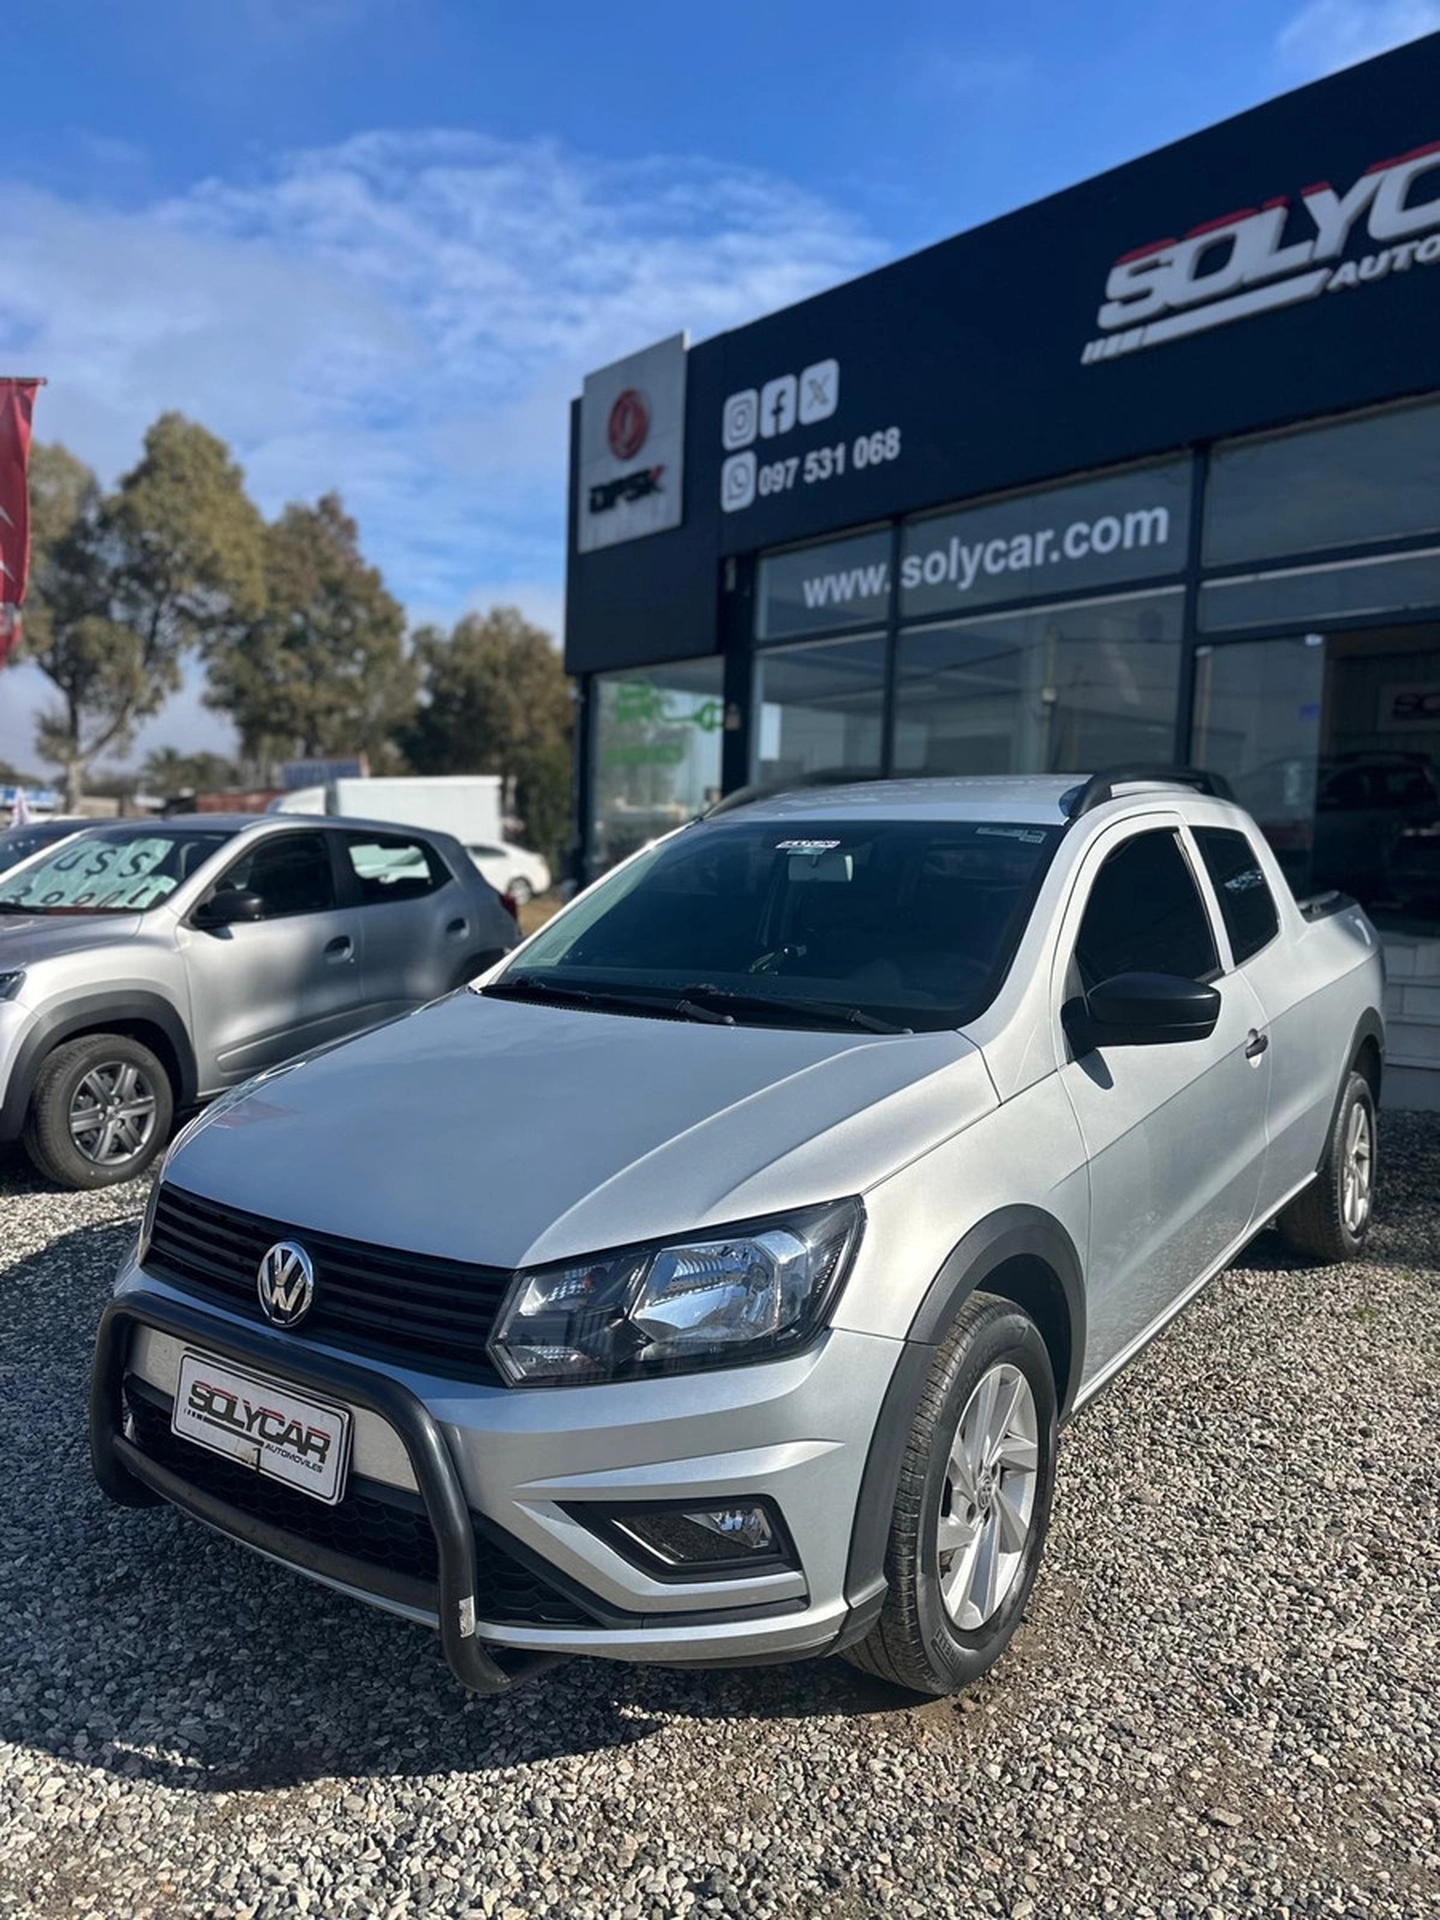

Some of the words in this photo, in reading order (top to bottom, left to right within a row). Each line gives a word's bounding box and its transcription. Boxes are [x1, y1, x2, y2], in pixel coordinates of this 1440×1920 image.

[758, 456, 800, 496] 097
[803, 442, 846, 484] 531
[852, 426, 901, 469] 068
[188, 1380, 331, 1464] SOLYCAR
[264, 1443, 323, 1474] AUTOMOVILES
